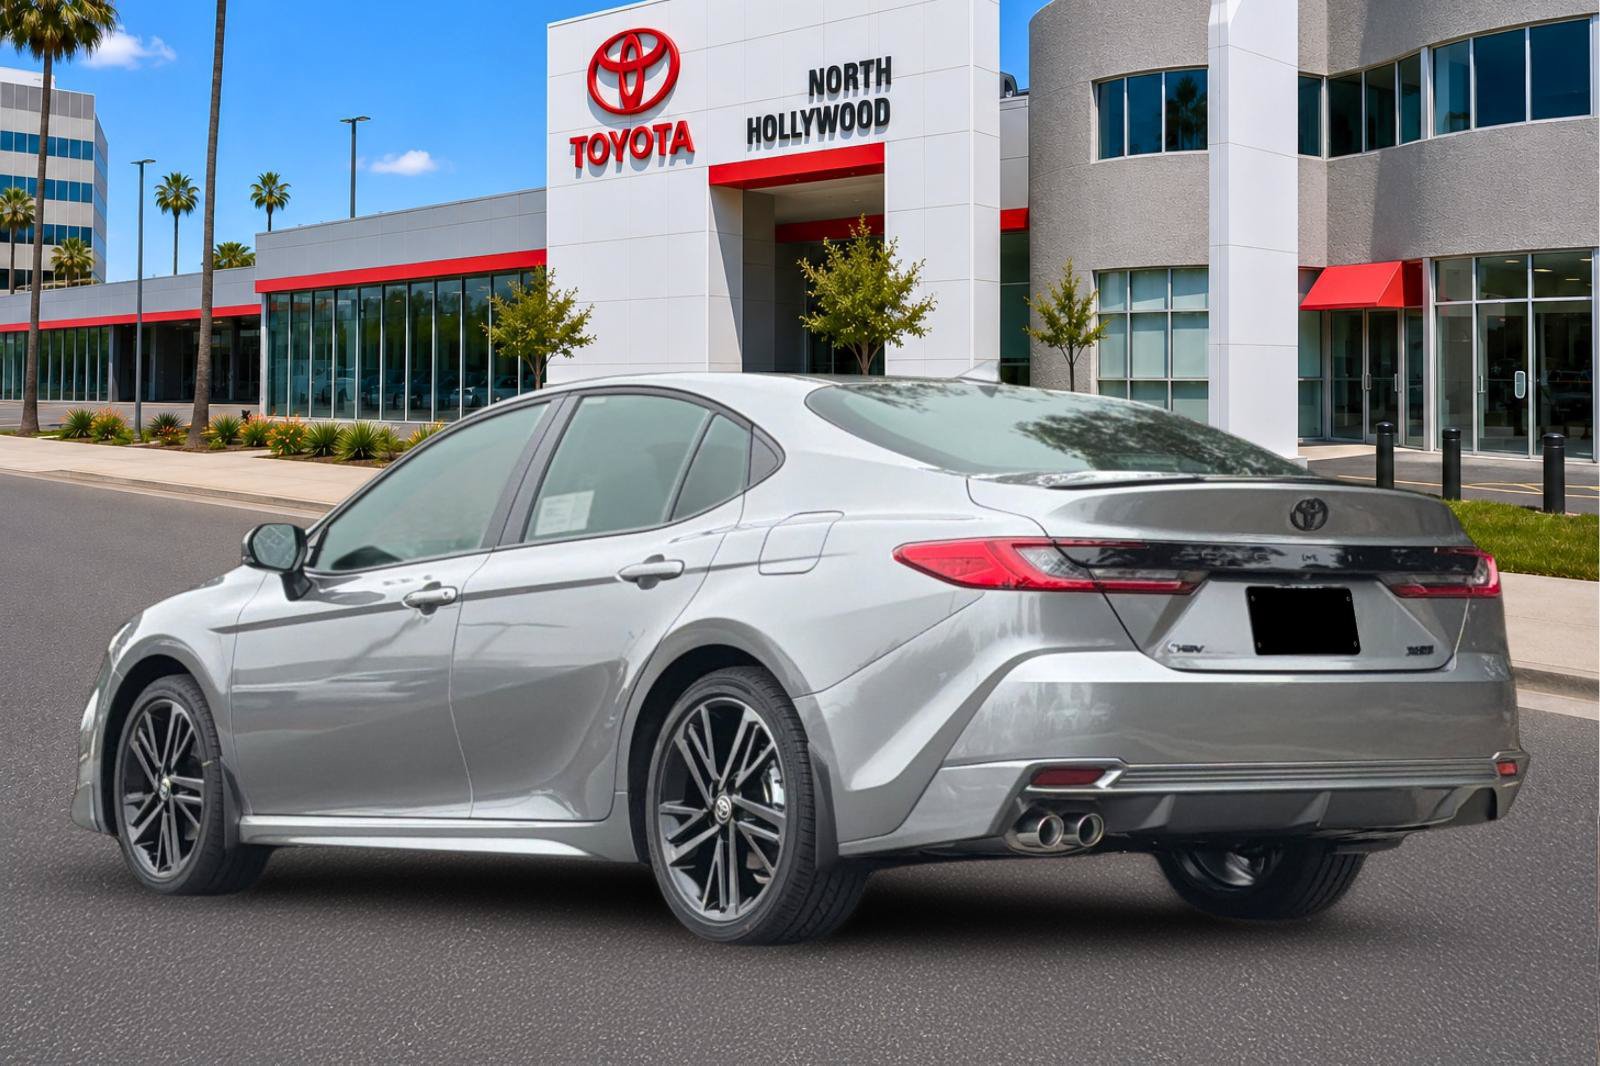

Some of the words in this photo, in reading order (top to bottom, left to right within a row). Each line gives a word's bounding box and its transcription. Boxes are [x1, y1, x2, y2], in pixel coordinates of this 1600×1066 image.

[808, 56, 892, 96] NORTH
[569, 120, 695, 168] TOYOTA
[746, 97, 890, 144] HOLLYWOOD
